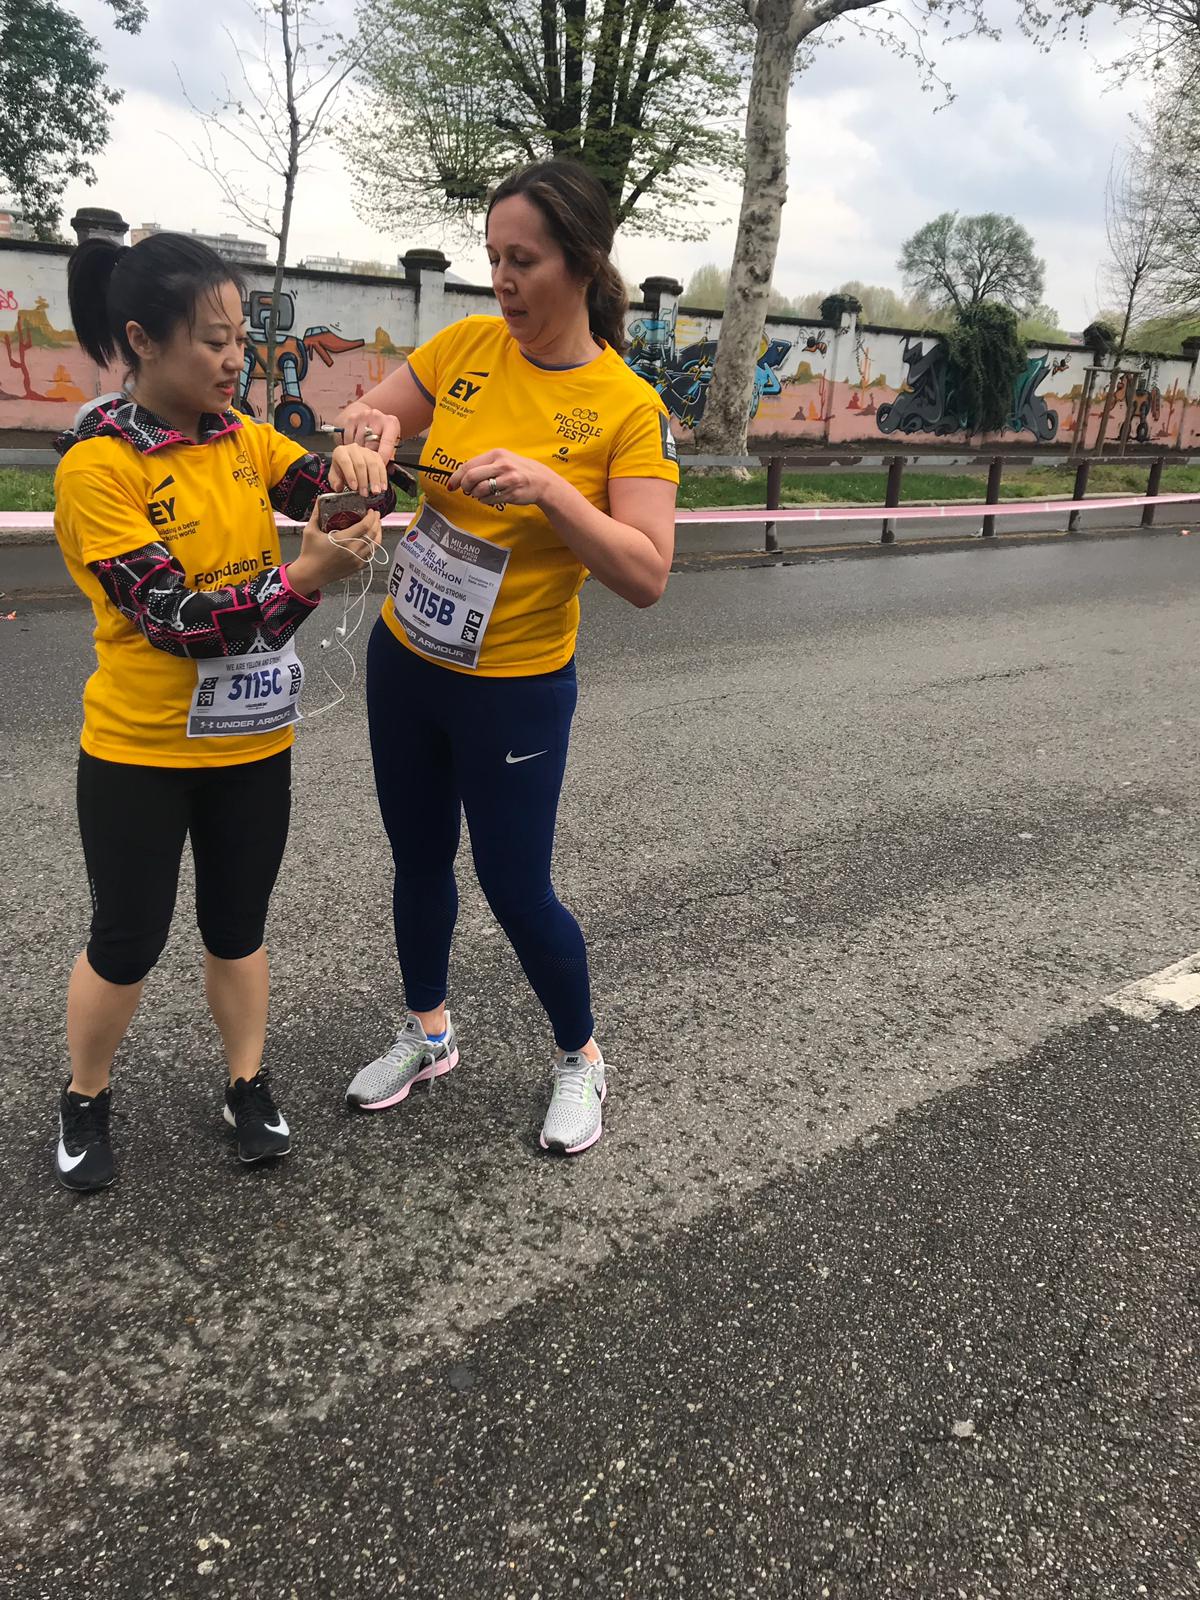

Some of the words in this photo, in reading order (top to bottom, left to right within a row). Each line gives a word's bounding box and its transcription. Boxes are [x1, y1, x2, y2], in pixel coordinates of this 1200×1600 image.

[448, 378, 482, 402] EY
[553, 413, 603, 437] PICCOLE
[147, 496, 176, 525] EY
[262, 550, 273, 566] E
[450, 538, 480, 554] MILANO
[420, 557, 463, 585] MARATHON
[425, 549, 448, 569] RELAY
[413, 566, 421, 576] ARE
[420, 572, 434, 587] YELLOW
[434, 581, 446, 593] AND
[445, 587, 467, 602] STRONG
[405, 576, 456, 626] 3115B
[417, 637, 465, 658] ARMOUR
[226, 663, 235, 671] WE
[235, 662, 246, 670] ARE
[227, 667, 283, 701] 3115C
[216, 719, 254, 729] UNDER
